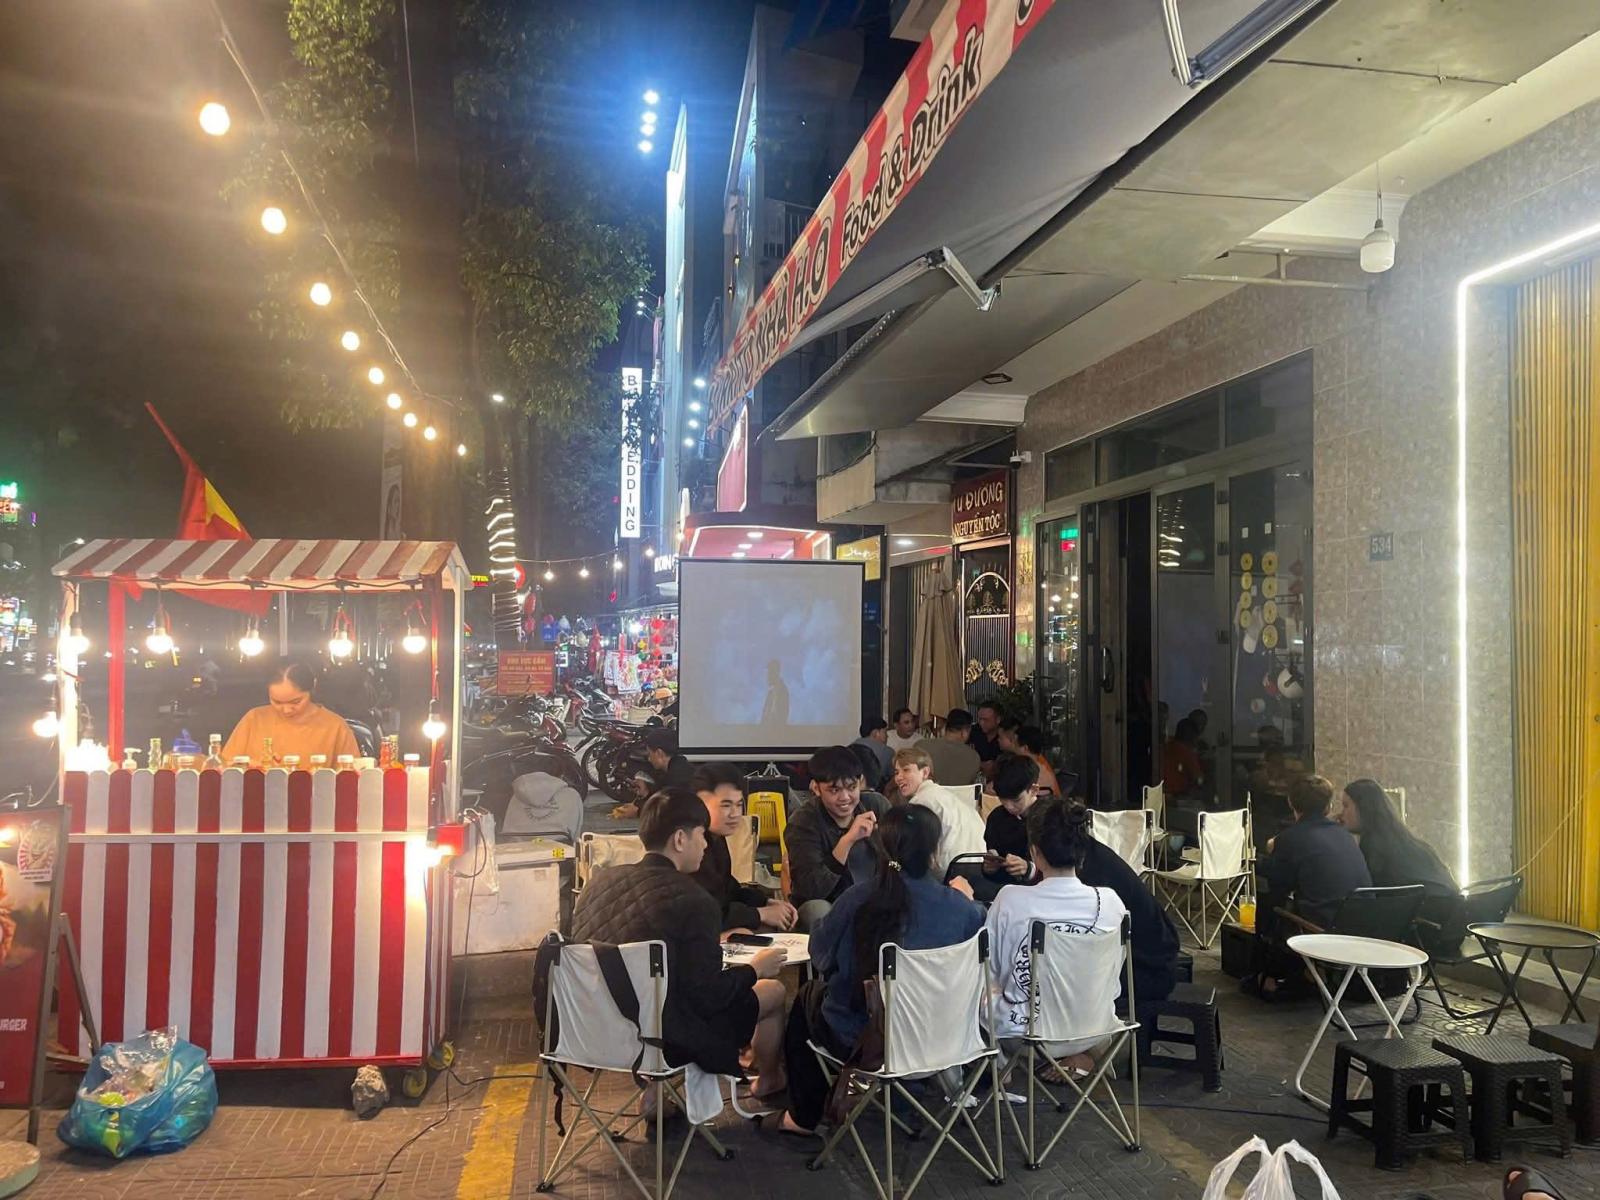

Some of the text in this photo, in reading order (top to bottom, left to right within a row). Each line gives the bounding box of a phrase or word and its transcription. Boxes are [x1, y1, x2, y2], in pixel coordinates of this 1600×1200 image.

[840, 156, 887, 264] Food
[887, 136, 907, 202] &
[908, 30, 983, 178] Drink
